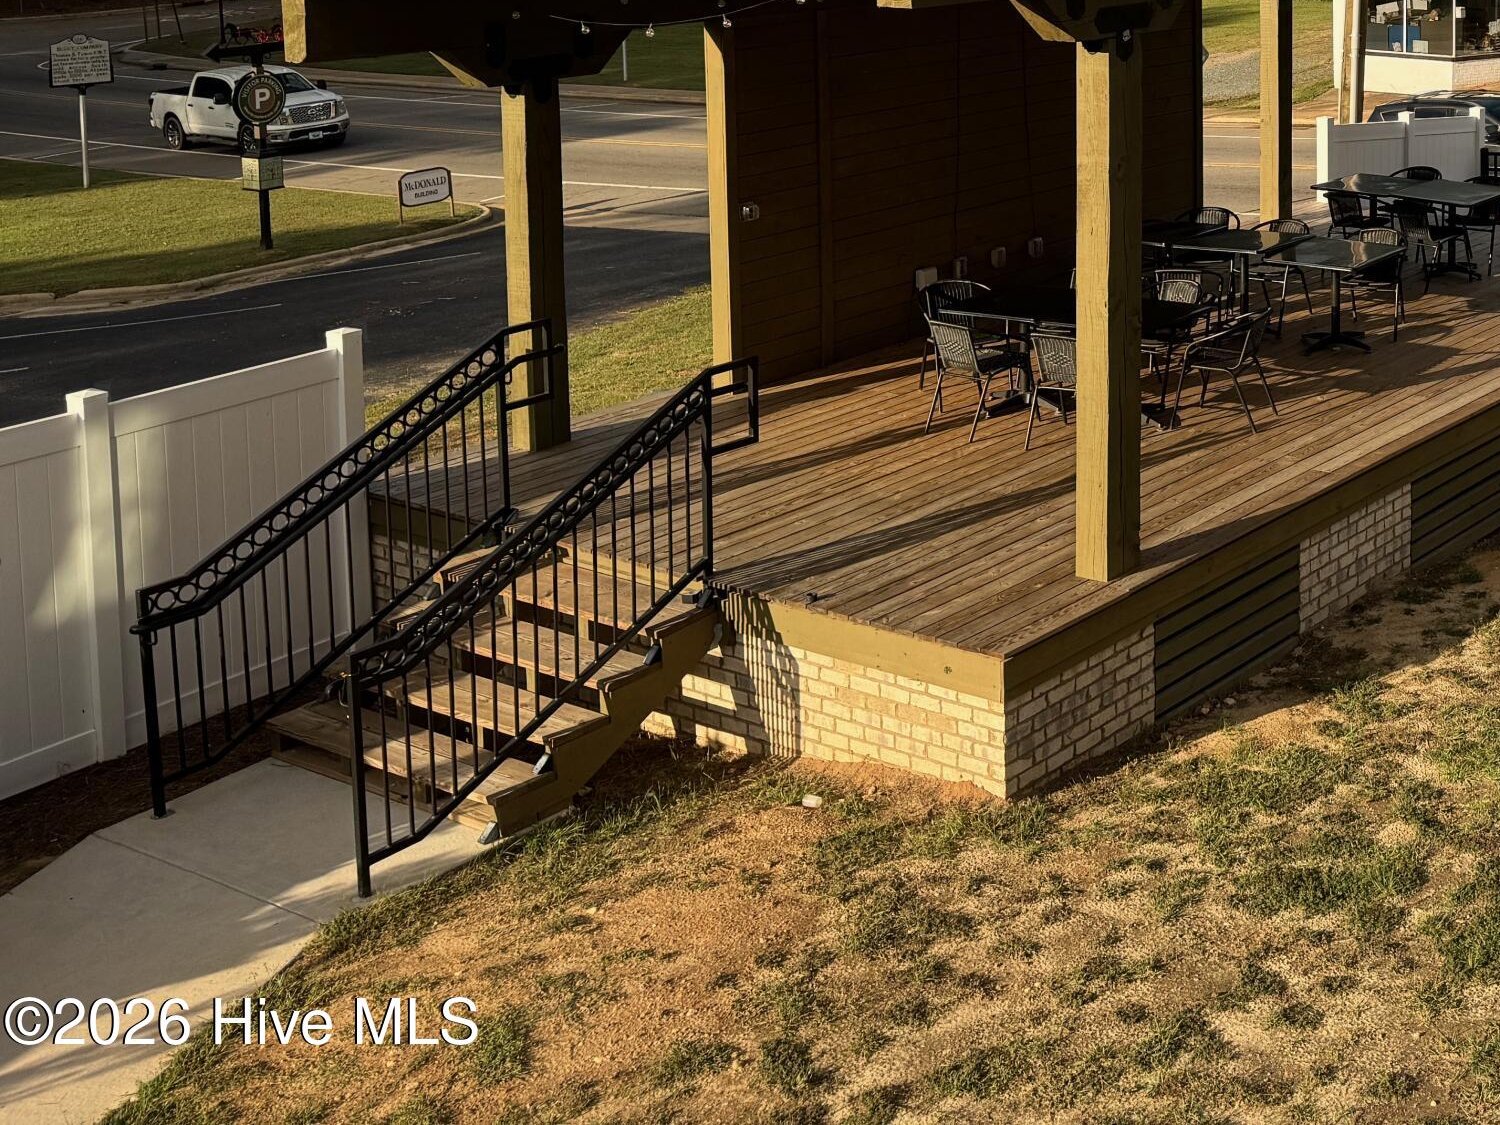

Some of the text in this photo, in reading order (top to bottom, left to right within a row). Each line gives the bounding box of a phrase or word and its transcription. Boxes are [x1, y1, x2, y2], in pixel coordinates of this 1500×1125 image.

[240, 78, 260, 98] VISITOR
[254, 88, 271, 110] P
[404, 176, 447, 192] McDONALD
